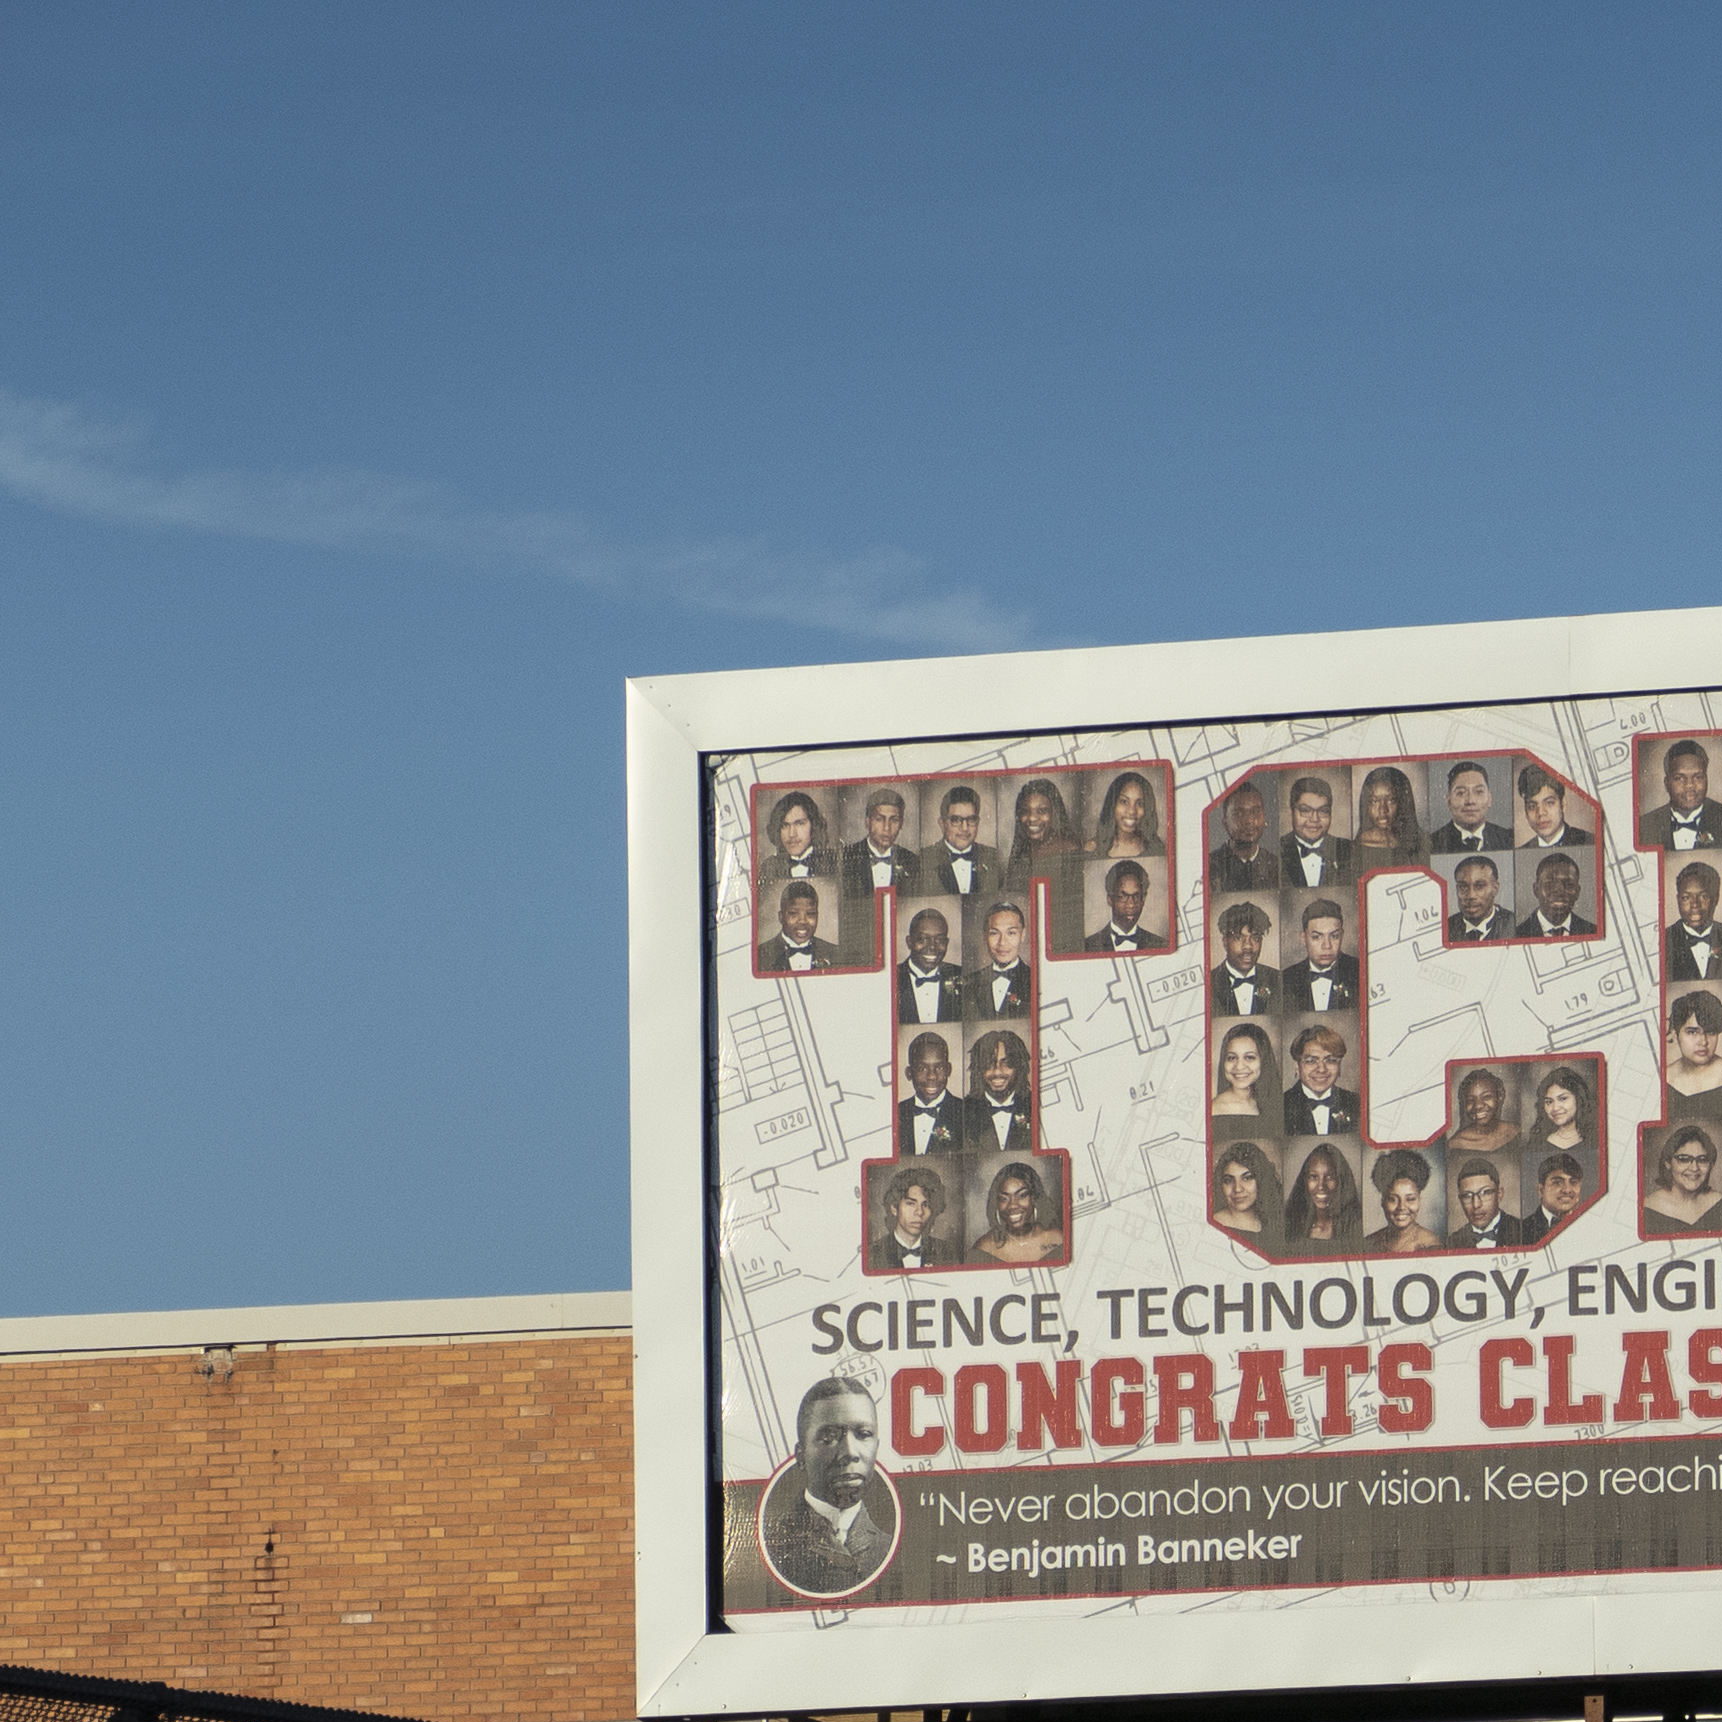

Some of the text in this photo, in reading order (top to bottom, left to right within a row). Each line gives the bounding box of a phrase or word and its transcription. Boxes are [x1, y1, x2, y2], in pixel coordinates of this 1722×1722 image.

[811, 1291, 1080, 1353] SCIENCE,
[1097, 1268, 1545, 1340] TECHNOLOGY,
[890, 1342, 1434, 1457] CONGRATS
[919, 1490, 1056, 1528] “Never
[1065, 1479, 1250, 1521] abandon
[1262, 1480, 1349, 1519] your
[1358, 1469, 1472, 1507] vision.
[1484, 1465, 1589, 1506] Keep
[968, 1534, 1126, 1578] Benjamin
[1138, 1529, 1302, 1565] Banneker
